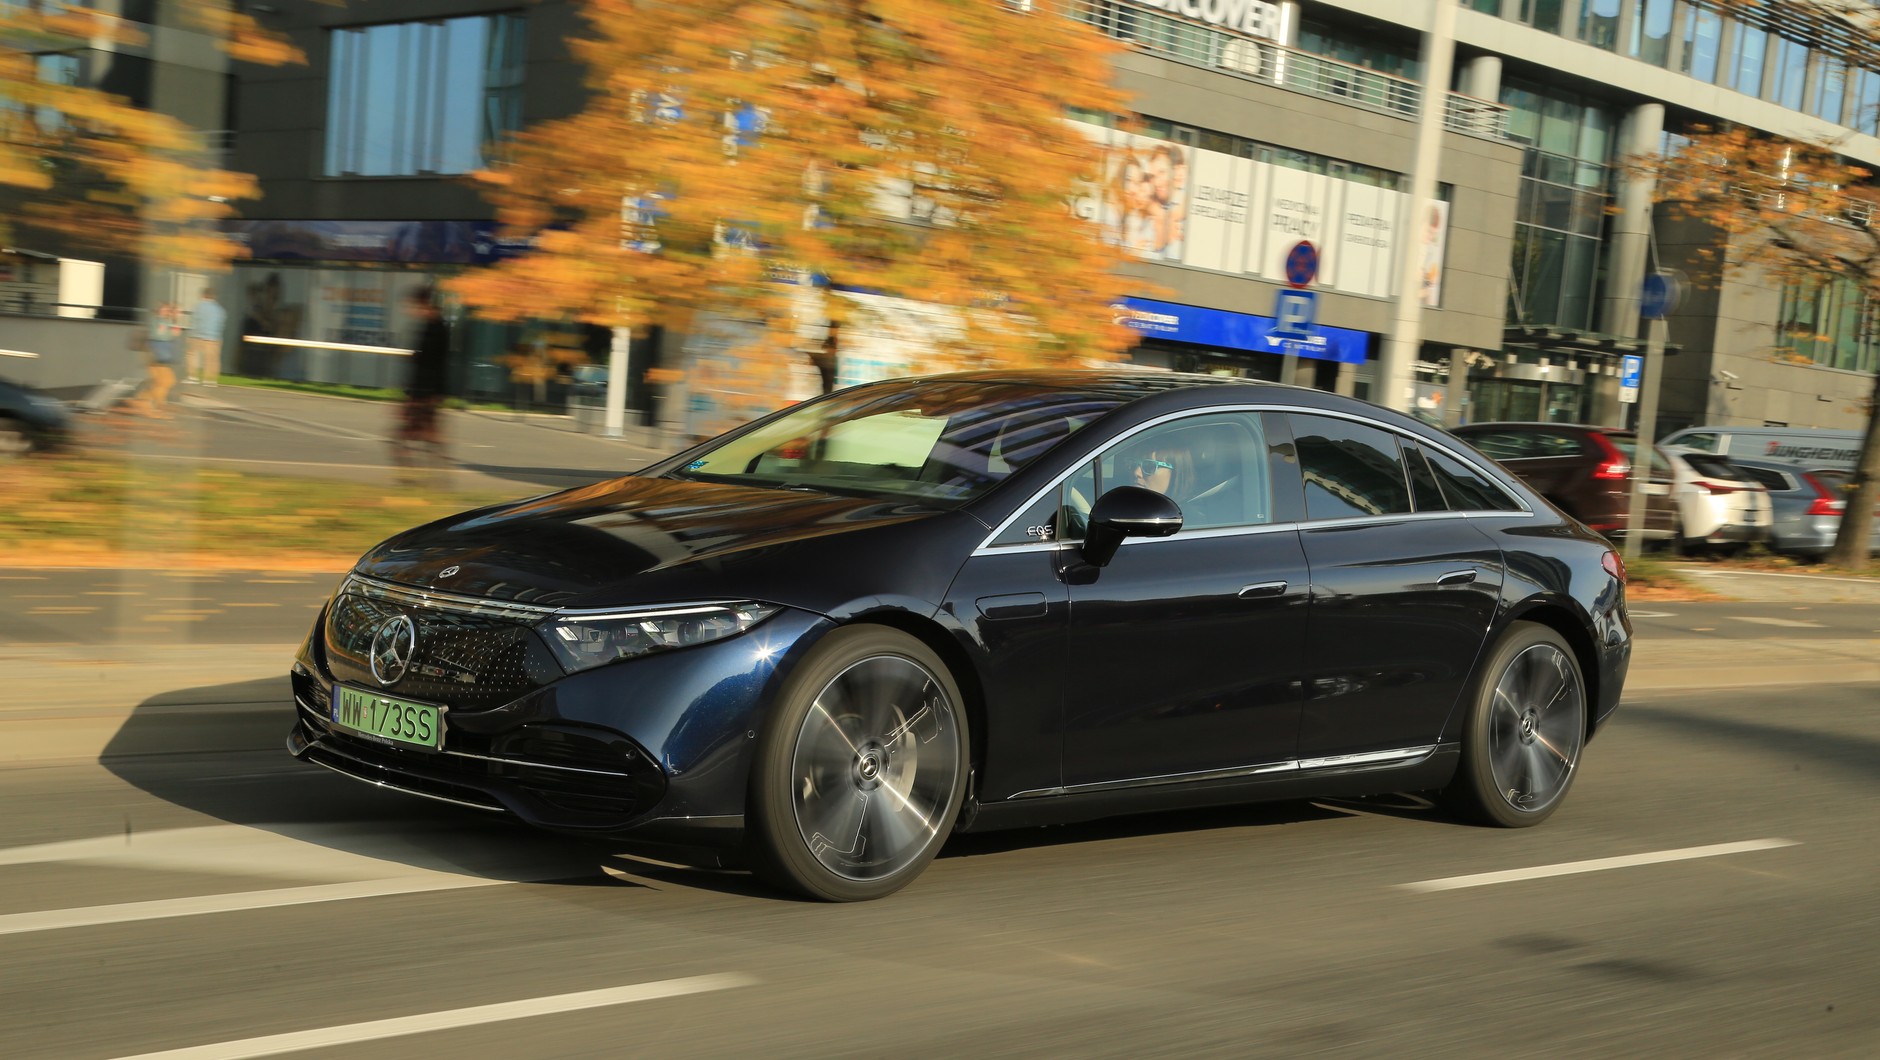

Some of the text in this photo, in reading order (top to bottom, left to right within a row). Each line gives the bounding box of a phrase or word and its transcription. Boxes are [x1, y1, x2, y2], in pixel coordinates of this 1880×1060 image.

[1624, 358, 1640, 378] P
[1027, 524, 1054, 536] EQS
[370, 698, 432, 742] 173SS
